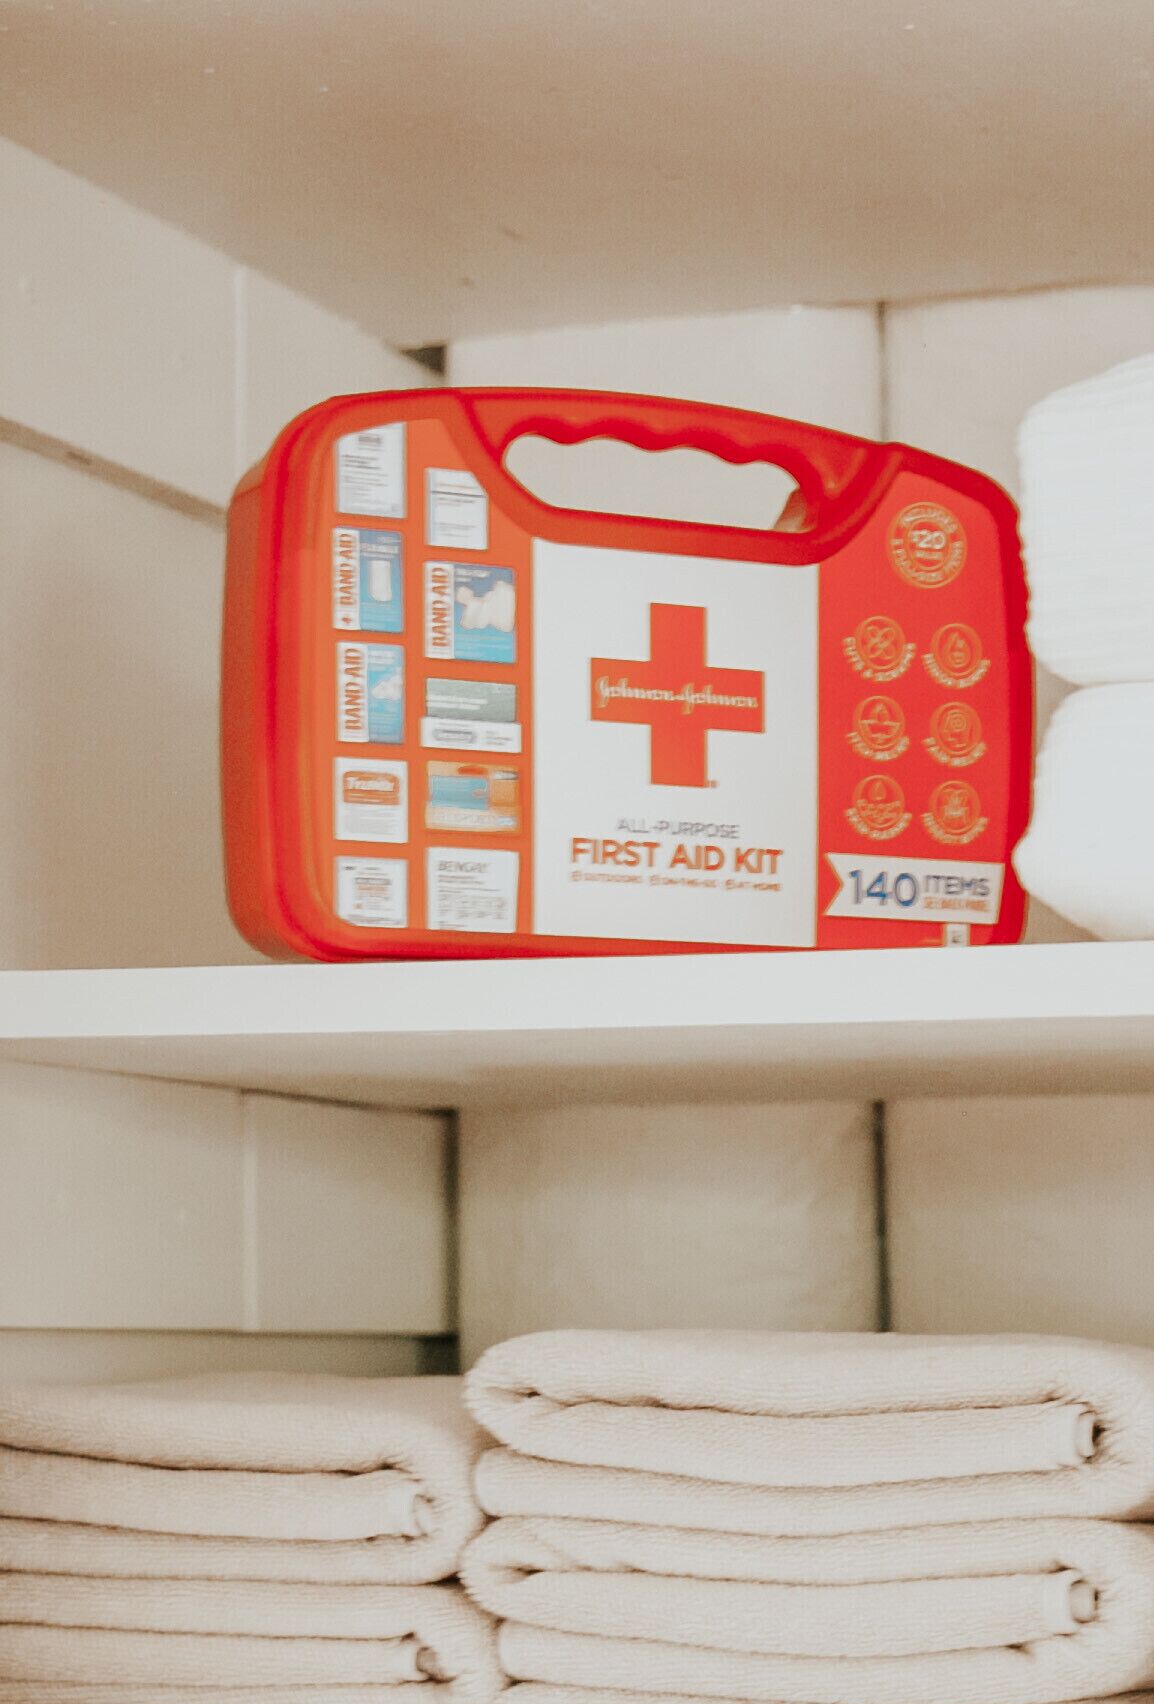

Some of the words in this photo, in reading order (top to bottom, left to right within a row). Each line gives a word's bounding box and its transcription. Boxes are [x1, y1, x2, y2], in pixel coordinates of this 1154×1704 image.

[617, 818, 740, 839] ALL-PURPOSE
[571, 837, 661, 867] FIRST
[670, 844, 725, 871] AID
[734, 848, 783, 874] KIT
[849, 869, 919, 907] 140
[924, 875, 990, 896] ITEMS
